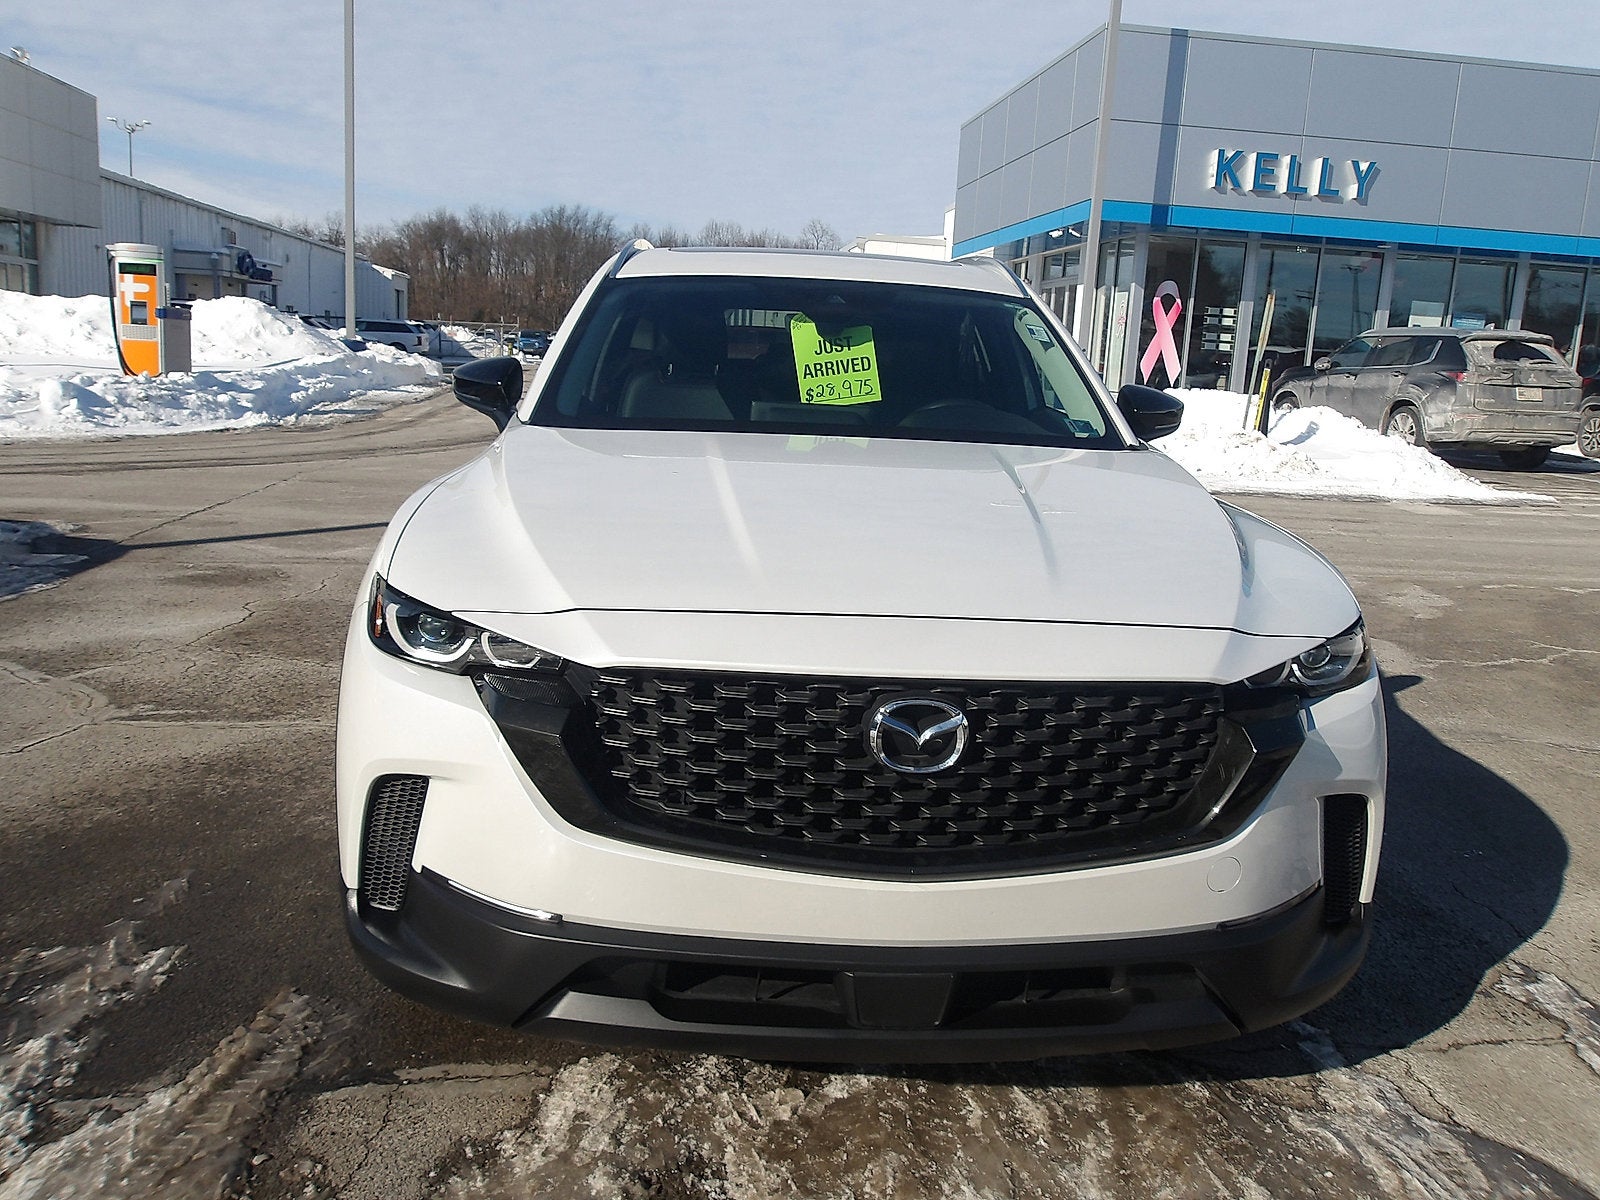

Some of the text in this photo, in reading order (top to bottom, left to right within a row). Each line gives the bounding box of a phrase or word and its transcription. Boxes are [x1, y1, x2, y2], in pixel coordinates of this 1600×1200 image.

[1210, 148, 1378, 202] KELLY
[814, 336, 853, 355] JUST
[803, 356, 871, 379] ARRIVED
[805, 379, 875, 403] $28,975
